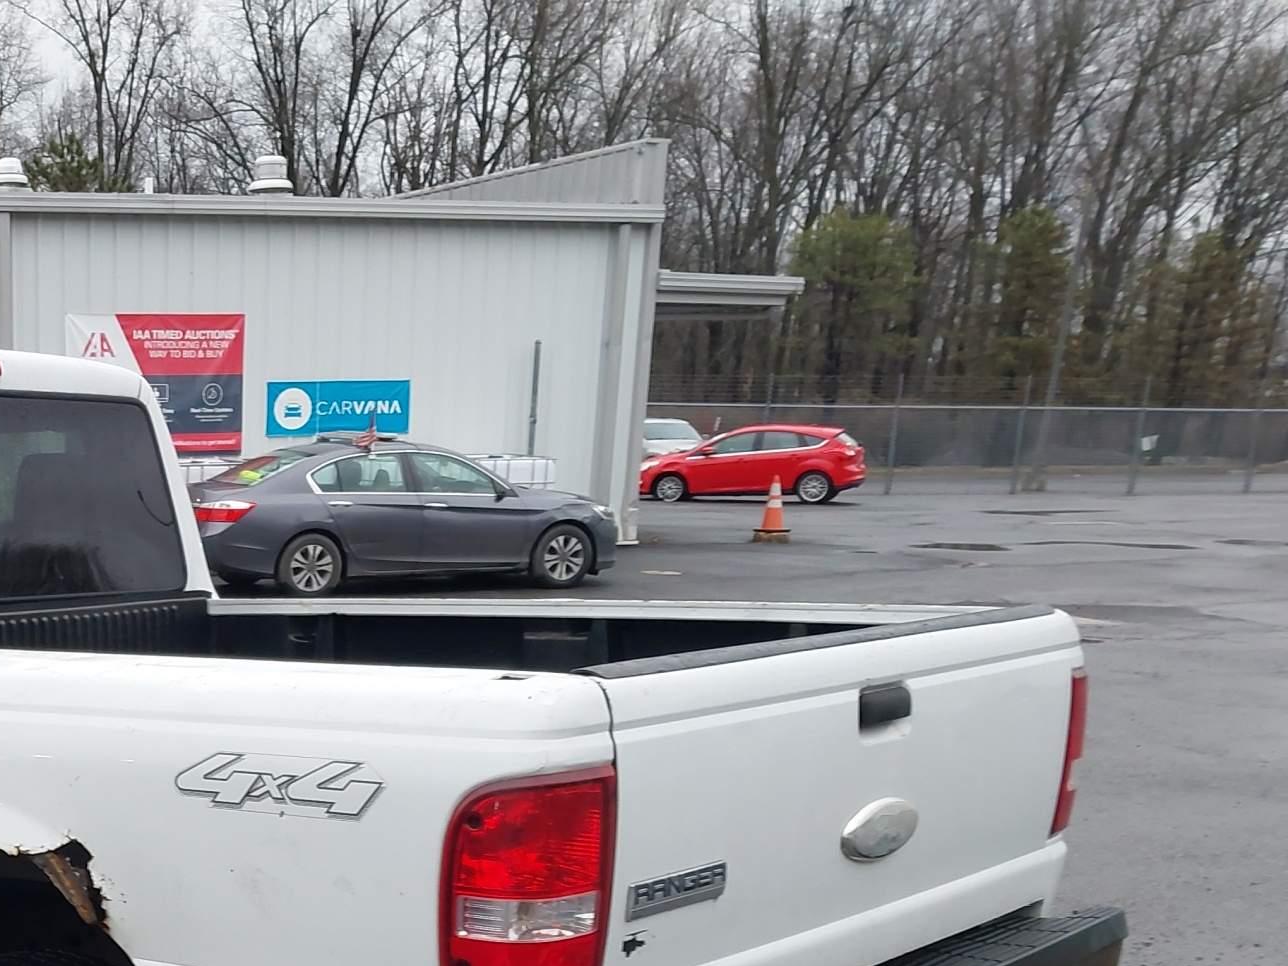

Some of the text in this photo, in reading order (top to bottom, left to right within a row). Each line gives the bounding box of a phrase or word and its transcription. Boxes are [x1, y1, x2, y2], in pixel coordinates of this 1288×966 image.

[133, 330, 151, 339] IAA
[151, 330, 183, 339] TIMED
[144, 340, 230, 349] INTRODUCING A NEW
[149, 350, 168, 358] WAY
[170, 350, 181, 358] TO
[206, 350, 224, 358] BUY
[316, 400, 402, 415] CARVANA
[175, 753, 385, 818] 4x4
[633, 862, 726, 905] RANGER
